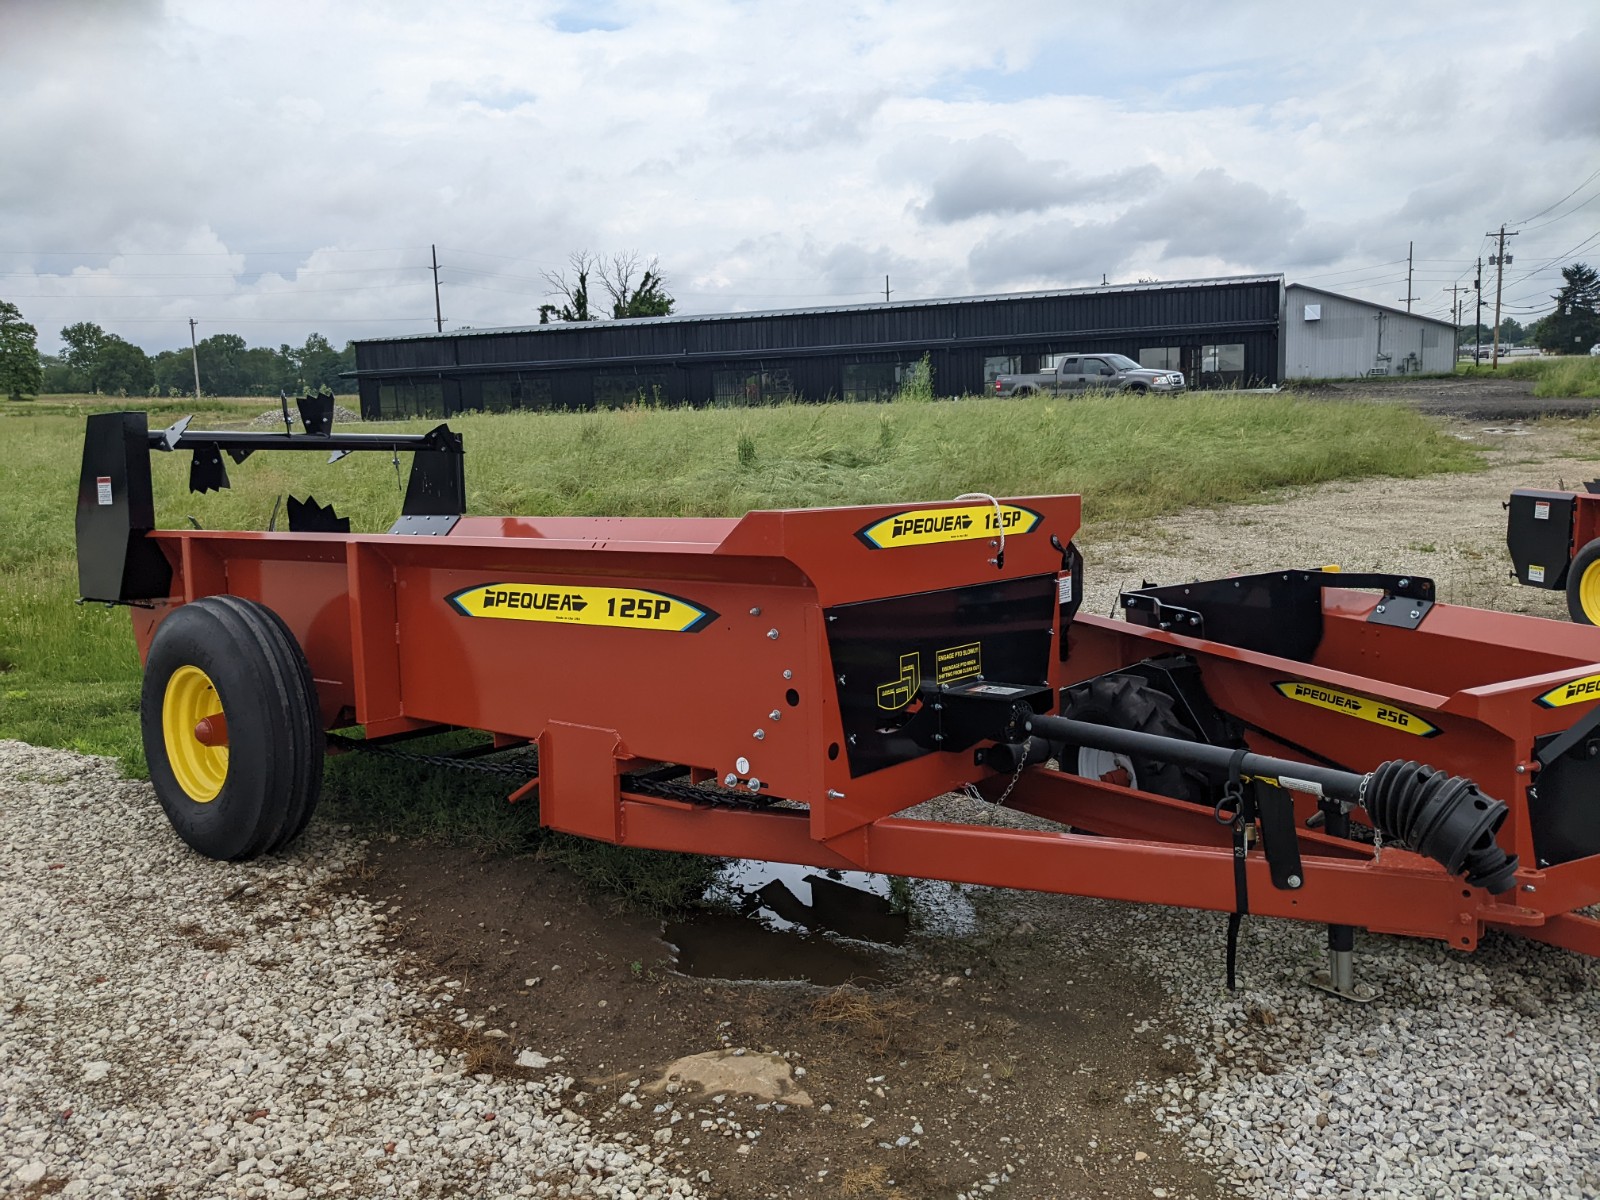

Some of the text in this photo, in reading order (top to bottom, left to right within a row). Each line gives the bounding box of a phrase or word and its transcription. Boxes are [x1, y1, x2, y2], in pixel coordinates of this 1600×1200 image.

[903, 511, 1021, 536] PEQUEA 125P
[495, 591, 671, 620] PEQUEA 125P
[938, 652, 955, 662] ENGAGE
[955, 650, 963, 658] PTO
[1303, 687, 1352, 709] PEQUEA
